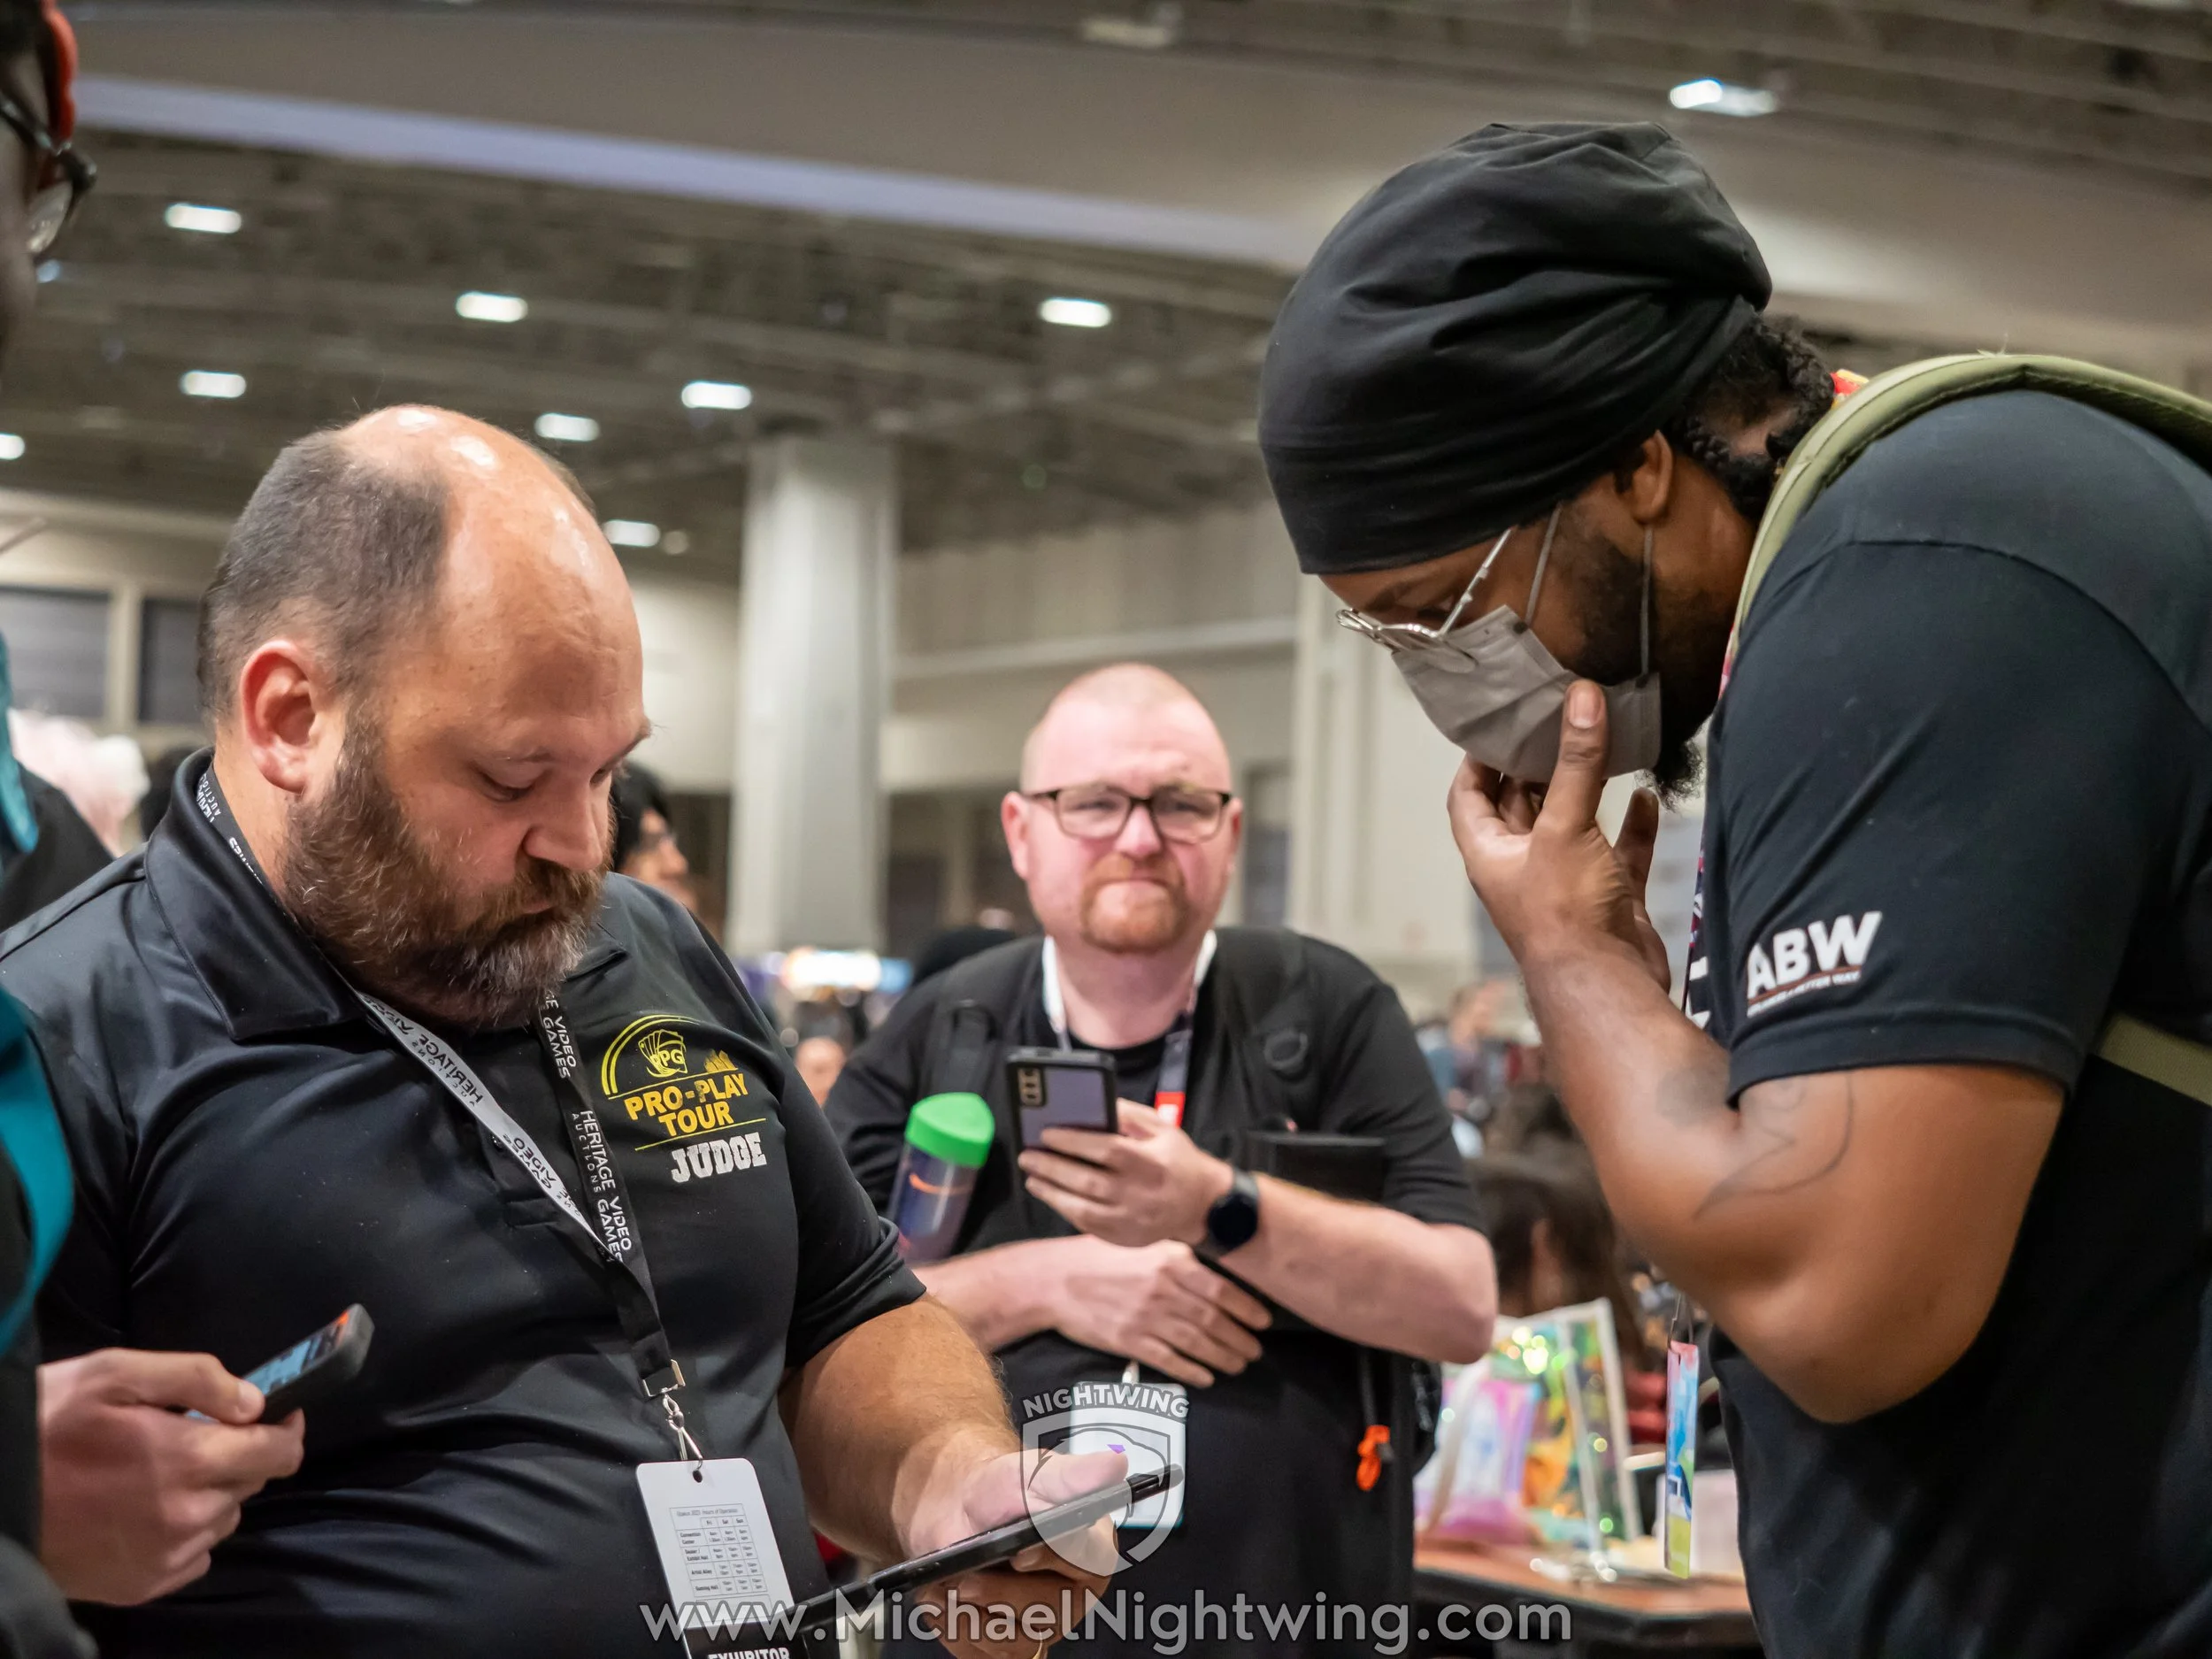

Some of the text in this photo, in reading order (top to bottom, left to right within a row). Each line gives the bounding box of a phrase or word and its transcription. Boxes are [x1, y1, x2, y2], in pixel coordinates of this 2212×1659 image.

[1747, 911, 1883, 1000] ABW
[543, 1018, 571, 1079] GAMES
[555, 1016, 576, 1067] VIDEO
[624, 1073, 749, 1120] PRO-PLAY
[658, 1102, 734, 1137] TOUR
[572, 1113, 602, 1194] AUCTIONS
[580, 1110, 616, 1192] HERITAGE
[671, 1132, 767, 1183] JUDGE
[610, 1195, 632, 1250] VIDEO
